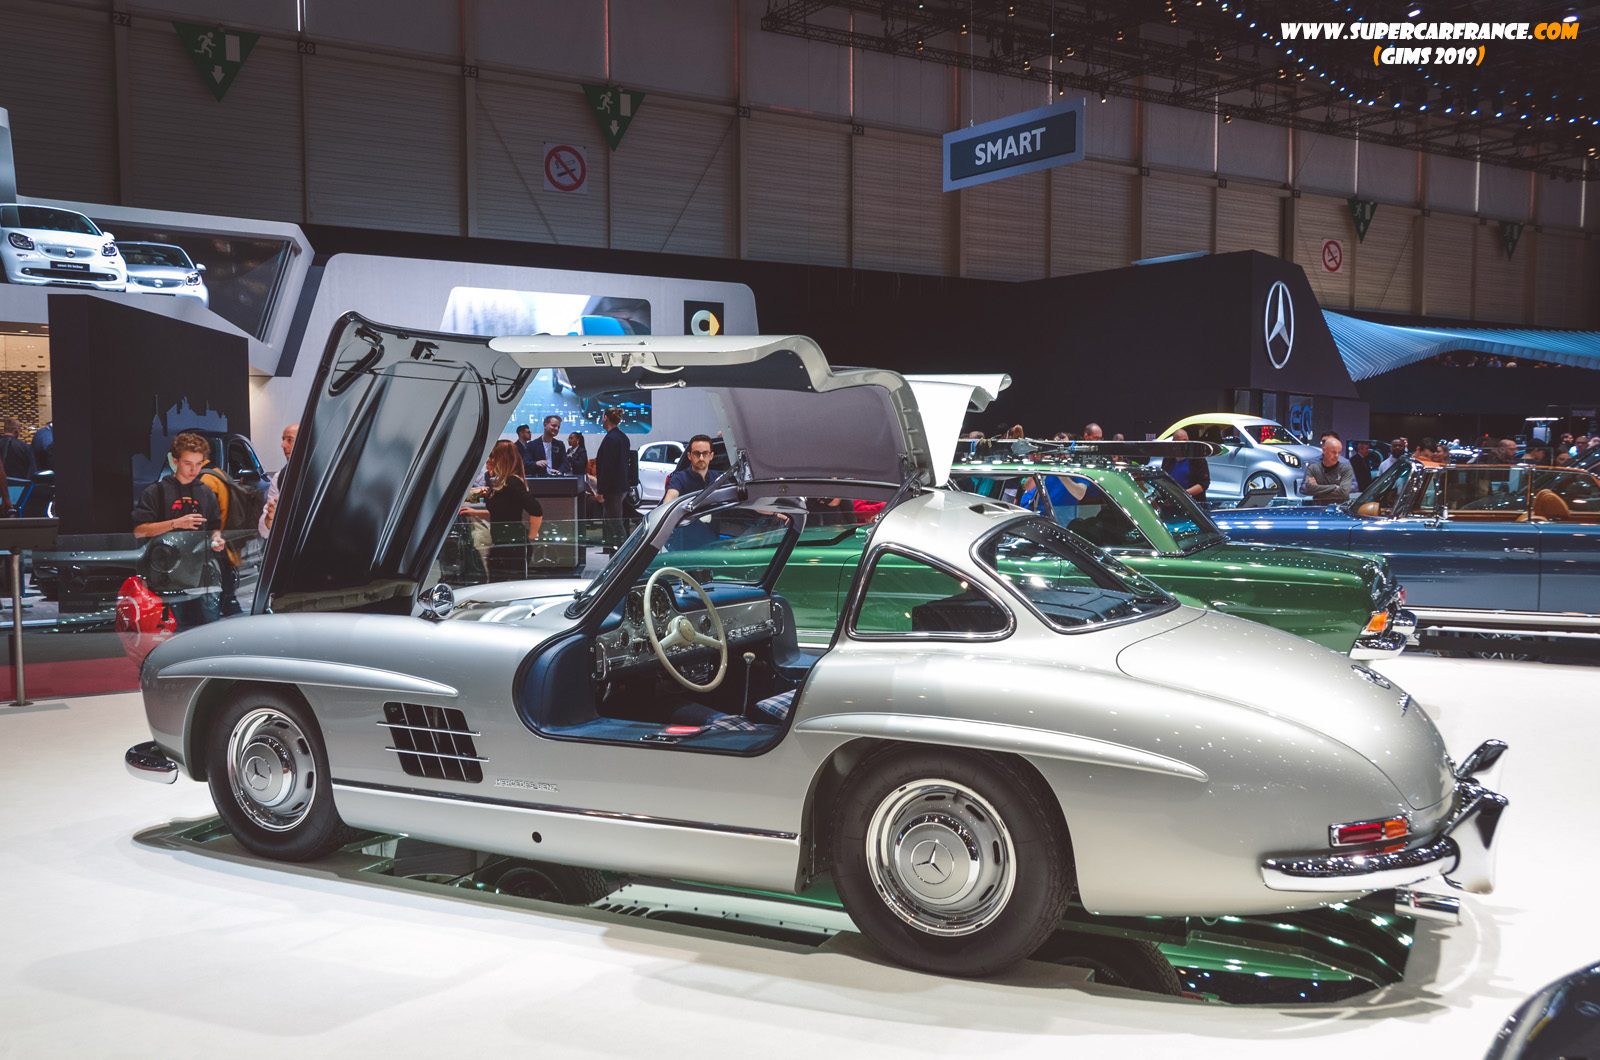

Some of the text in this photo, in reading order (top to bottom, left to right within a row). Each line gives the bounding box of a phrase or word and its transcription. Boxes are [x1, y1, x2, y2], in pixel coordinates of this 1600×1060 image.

[112, 12, 130, 25] 27
[299, 42, 314, 54] 26
[463, 66, 478, 77] 25
[738, 107, 750, 117] 23
[853, 125, 864, 135] 22
[975, 126, 1046, 166] SMART
